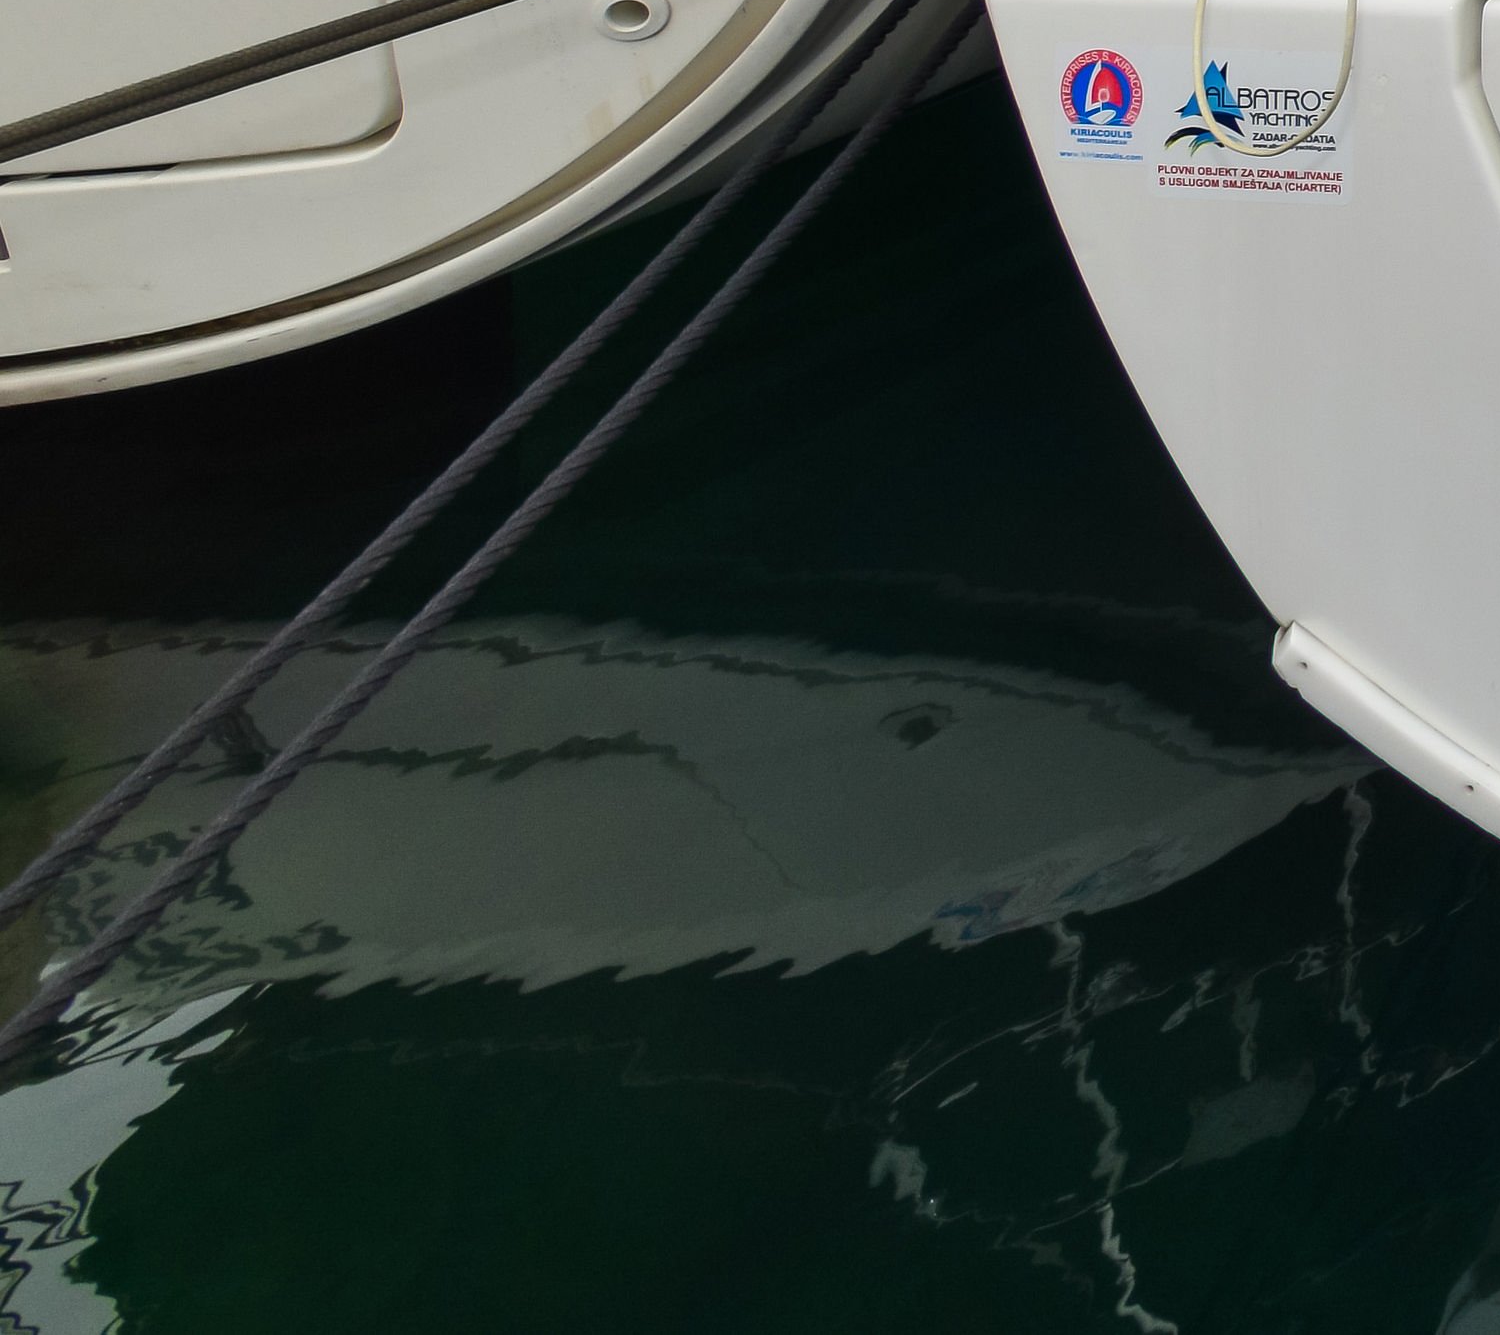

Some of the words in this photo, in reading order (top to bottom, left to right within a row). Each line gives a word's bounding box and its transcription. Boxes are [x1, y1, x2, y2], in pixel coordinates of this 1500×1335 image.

[1071, 128, 1132, 139] KIRIACOULIS
[1157, 165, 1195, 175] PLOVNI
[1197, 166, 1238, 177] OBJEKT
[1241, 168, 1254, 177] ZA
[1257, 169, 1343, 182] IZNAJMLJIVANJE
[1159, 177, 1166, 185] S
[1169, 178, 1219, 188] USLUGOM
[1222, 177, 1282, 190] SMJEŠTAJA
[1285, 183, 1342, 195] (CHARTER)
